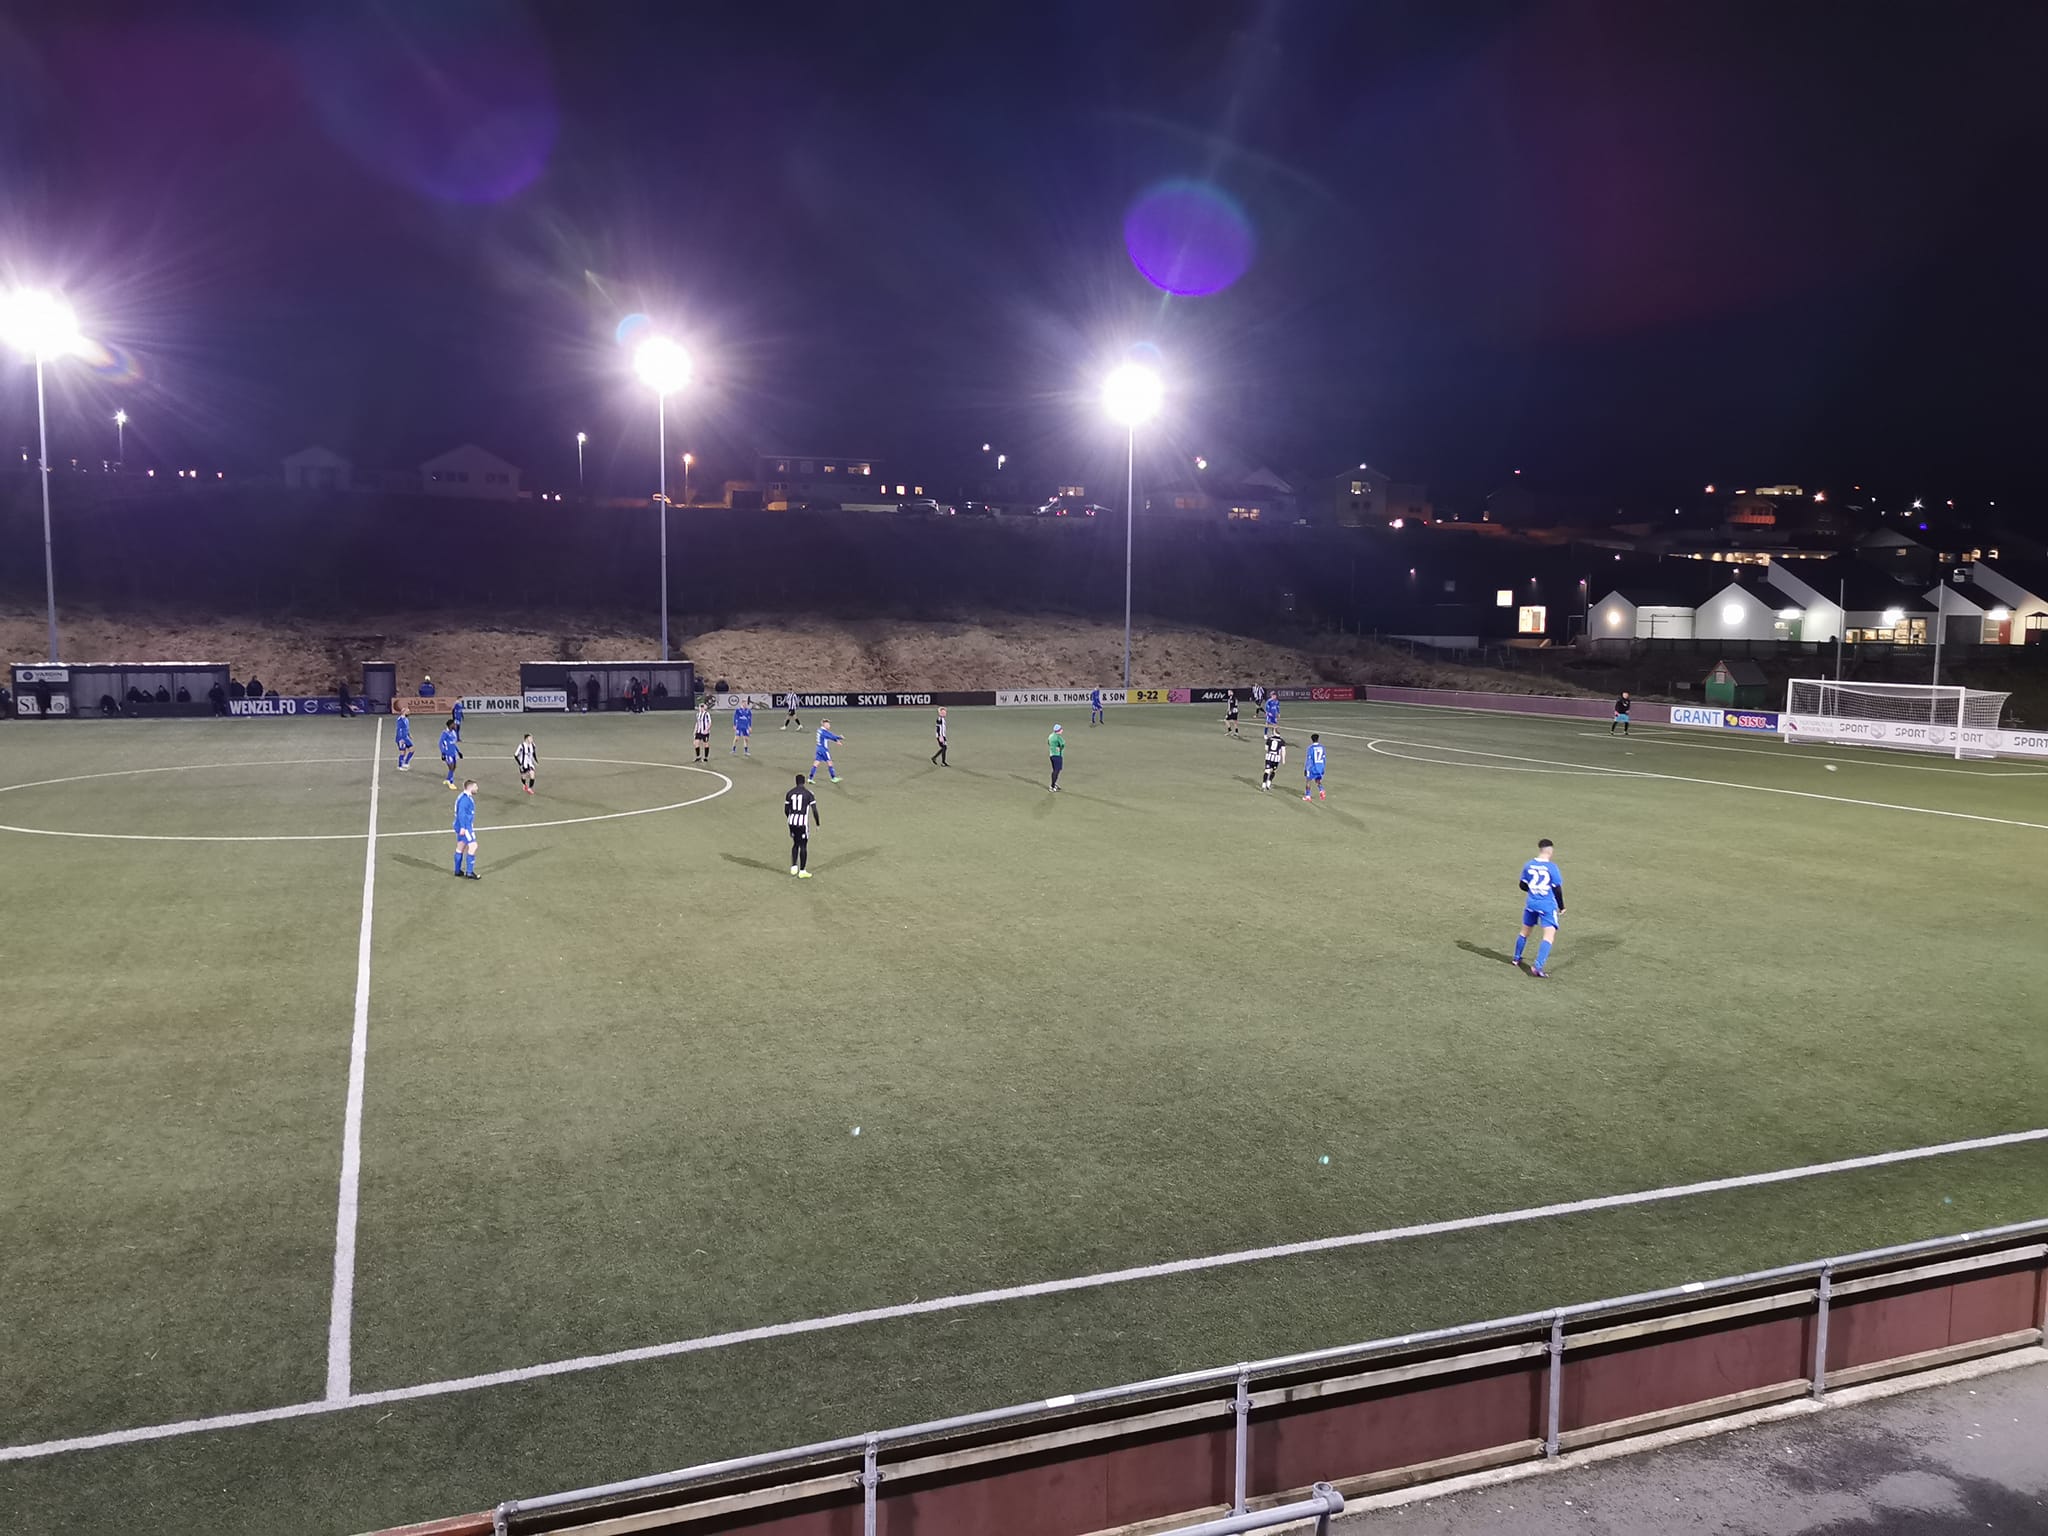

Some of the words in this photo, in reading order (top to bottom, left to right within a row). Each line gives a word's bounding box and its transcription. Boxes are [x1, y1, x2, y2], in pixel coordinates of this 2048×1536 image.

[526, 695, 566, 703] ROEST.FO
[776, 695, 848, 706] BAKNORDIK
[858, 694, 887, 705] SKYN
[896, 694, 931, 705] TRYGD
[1110, 692, 1125, 701] SON
[1137, 690, 1158, 700] 9-22
[229, 699, 296, 714] WENZEL.FO
[461, 699, 482, 710] LEIF
[486, 699, 520, 710] MOHR
[1673, 708, 1721, 725] GRANT
[1739, 715, 1767, 729] SISU
[1839, 722, 1870, 734] SPORT
[1895, 726, 1927, 739] SPORT
[1949, 731, 1984, 743] SORT
[2013, 736, 2048, 749] SPORT
[790, 793, 803, 811] 11
[1527, 868, 1551, 891] 22
